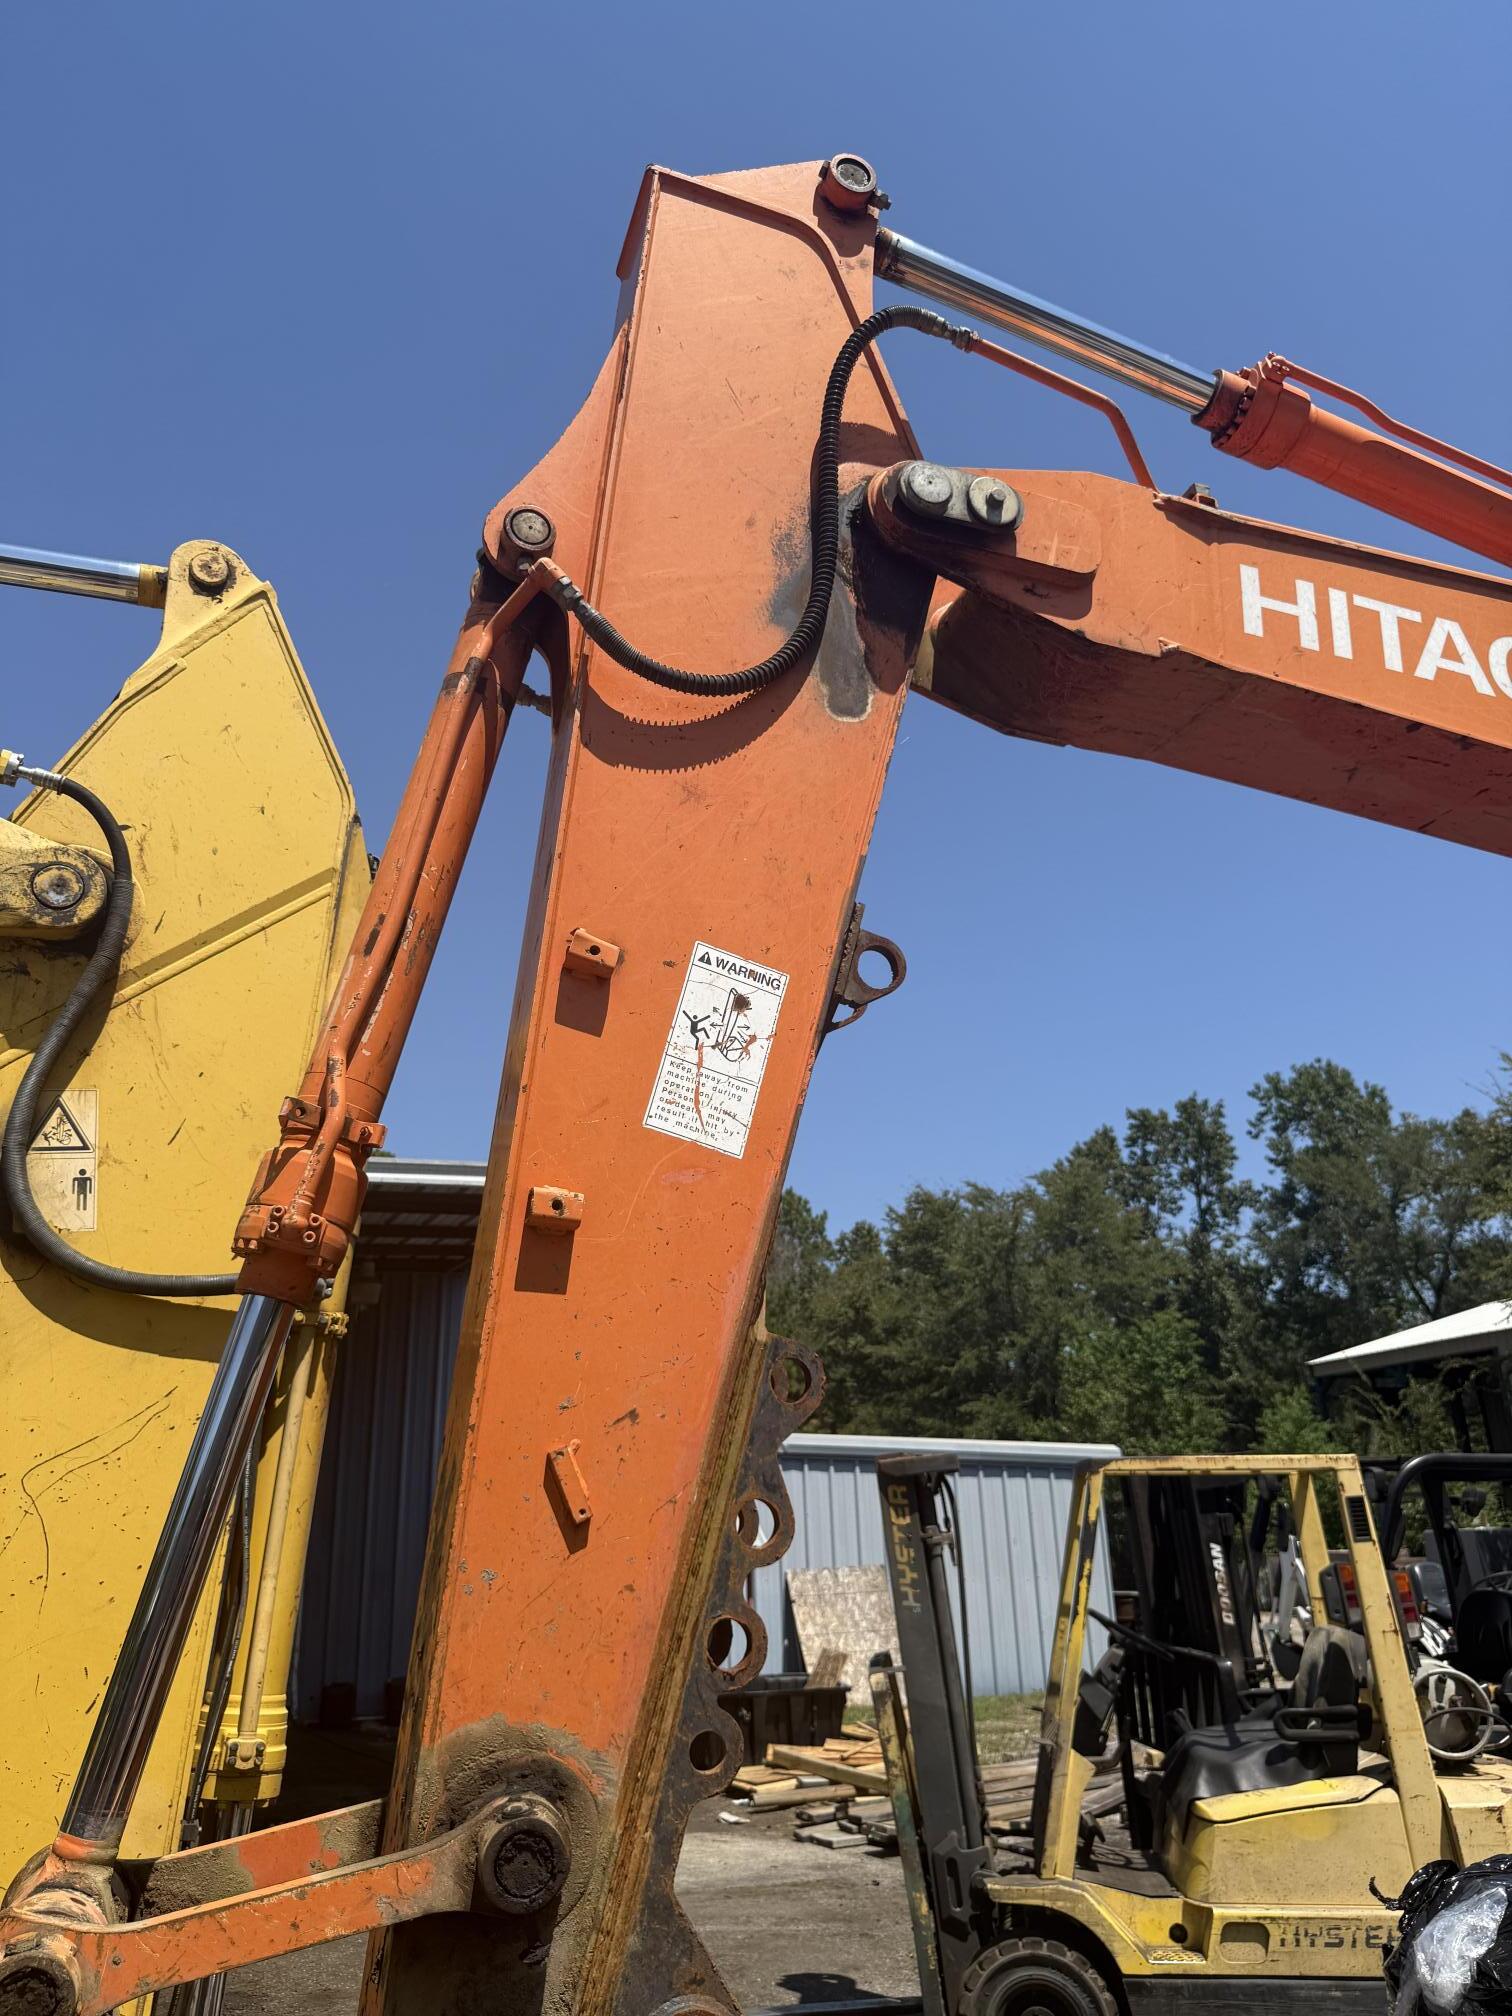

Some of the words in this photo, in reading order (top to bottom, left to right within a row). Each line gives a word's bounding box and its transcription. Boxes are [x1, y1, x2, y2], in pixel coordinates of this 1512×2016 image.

[715, 956, 781, 991] WARNING
[667, 1070, 706, 1088] machine
[712, 1085, 742, 1101] during
[669, 1060, 692, 1074] Keep
[697, 1072, 721, 1084] away
[728, 1082, 748, 1093] from
[662, 1087, 704, 1107] Personl
[654, 1112, 669, 1123] the
[656, 1105, 686, 1119] result
[705, 1120, 718, 1130] hit
[723, 1127, 734, 1137] by
[708, 1113, 726, 1124] may
[887, 1484, 921, 1607] HYSTER
[1209, 1542, 1236, 1625] DOOSAN
